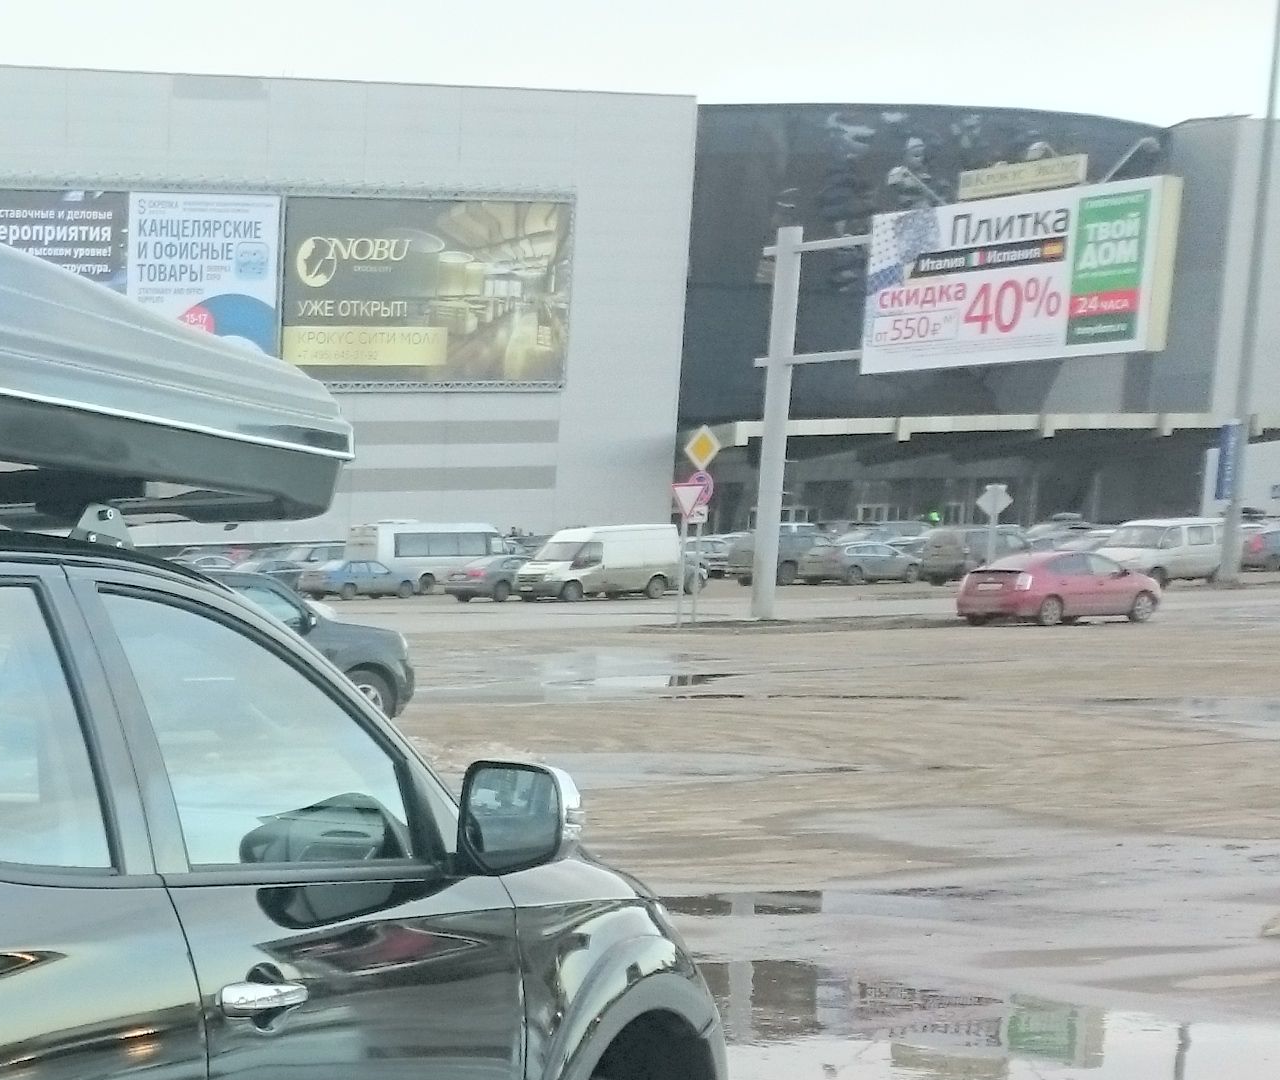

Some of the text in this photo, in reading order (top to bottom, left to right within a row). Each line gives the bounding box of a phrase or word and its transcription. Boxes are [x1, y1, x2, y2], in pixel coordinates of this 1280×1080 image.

[58, 210, 65, 219] и
[66, 210, 113, 221] деловые
[138, 218, 262, 240] КАНЦЕЛЯРСКИЕ
[951, 207, 1071, 247] Плитка
[1085, 211, 1141, 242] ТВОЙ
[73, 246, 112, 259] уровне!
[137, 241, 234, 261] И ОФИСНЫЕ
[325, 237, 412, 261] NOBU
[919, 246, 1041, 272] Италия Испания
[1077, 238, 1138, 271] ДОМ
[137, 263, 203, 282] ТОВАРЫ
[298, 300, 408, 317] УЖЕ ОТКРЫТ!
[878, 276, 1062, 335] скидка 40%
[185, 313, 208, 324] 15-17
[298, 331, 354, 345] КРОКУС
[358, 331, 396, 345] СИТИ
